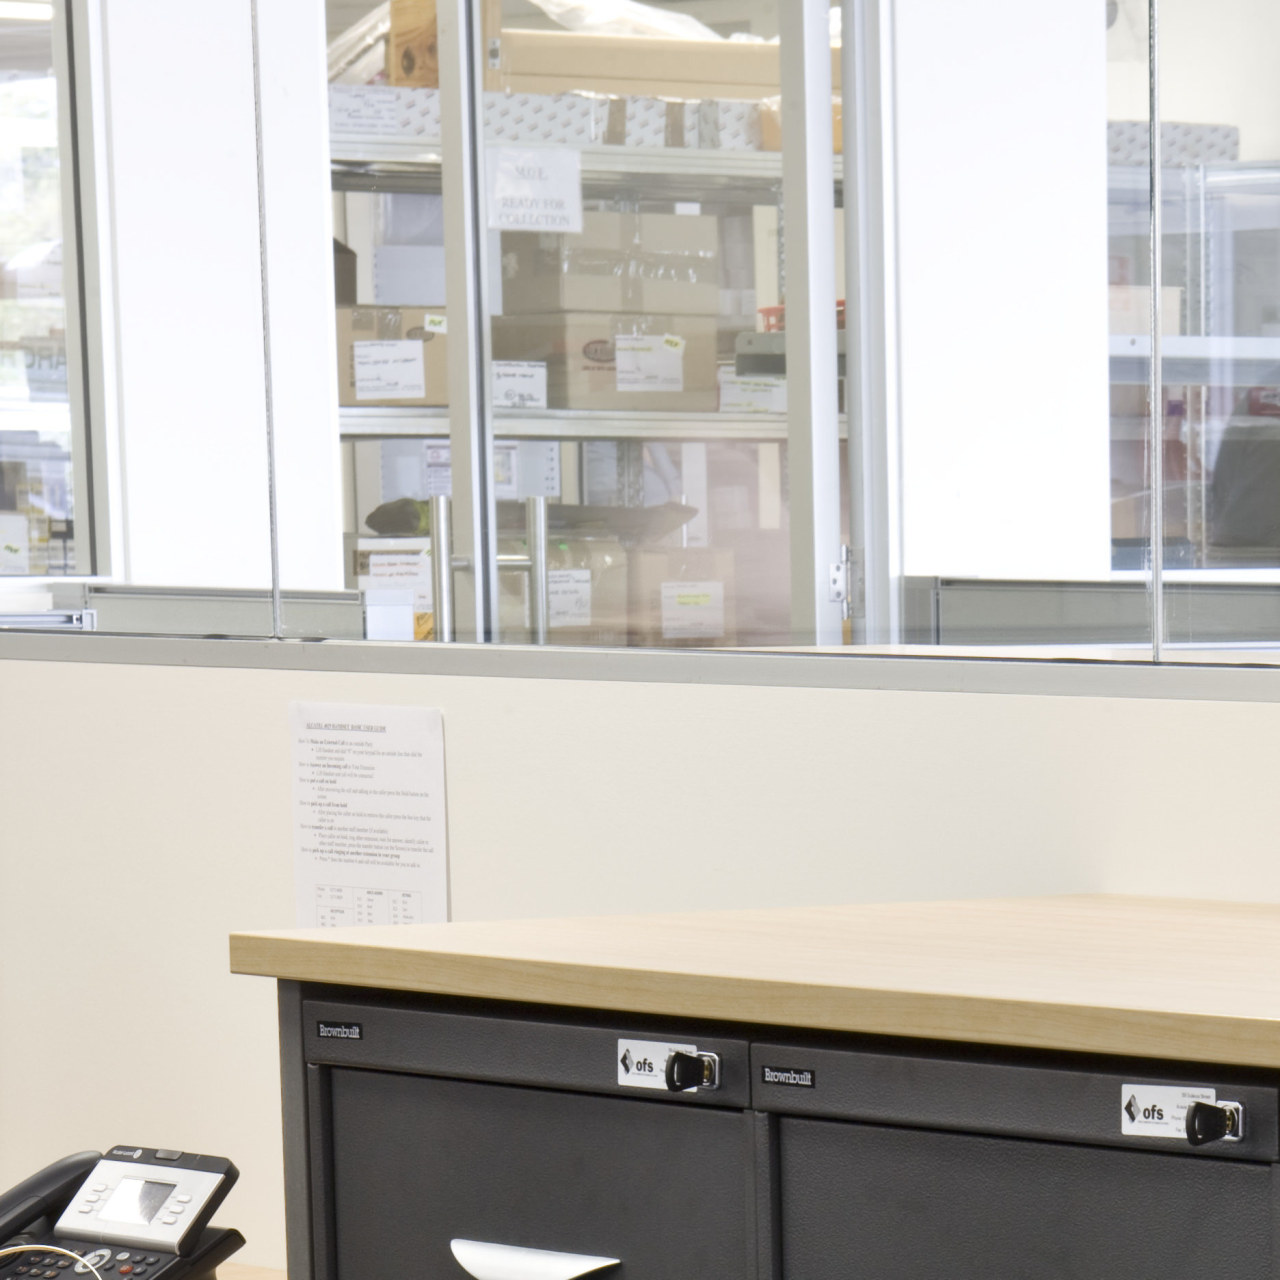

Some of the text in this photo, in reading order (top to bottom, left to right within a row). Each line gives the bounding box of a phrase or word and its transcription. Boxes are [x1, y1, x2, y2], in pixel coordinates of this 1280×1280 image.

[502, 197, 566, 211] READY FOR
[498, 213, 570, 226] COLLECTION
[319, 1024, 360, 1039] Brownbuilt
[636, 1058, 654, 1073] ofs
[764, 1067, 812, 1086] Brownbuilt
[1142, 1104, 1164, 1120] ofs
